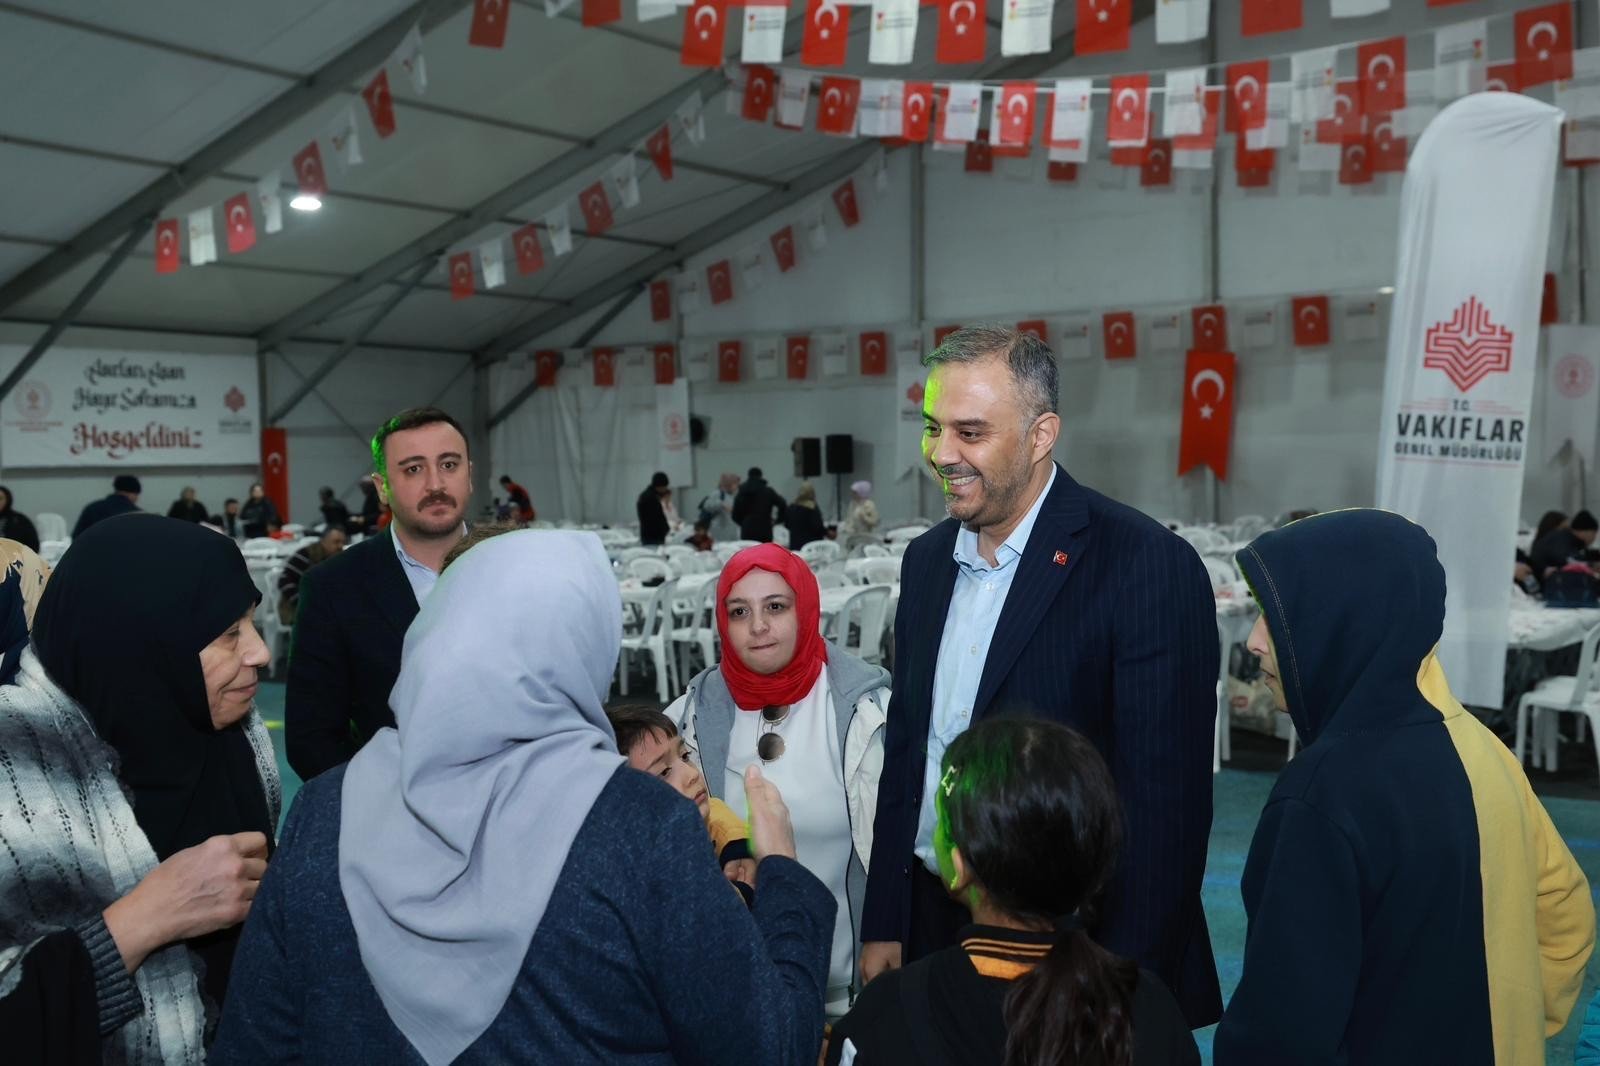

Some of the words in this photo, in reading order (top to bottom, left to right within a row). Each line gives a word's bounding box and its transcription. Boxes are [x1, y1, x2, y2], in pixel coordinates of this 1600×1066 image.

[71, 422, 203, 459] Hoşgeldiniz
[1397, 413, 1524, 443] VAKIFLAR
[1395, 442, 1433, 455] GENEL
[1440, 444, 1522, 461] MÜDÜRLÜĞÜ
